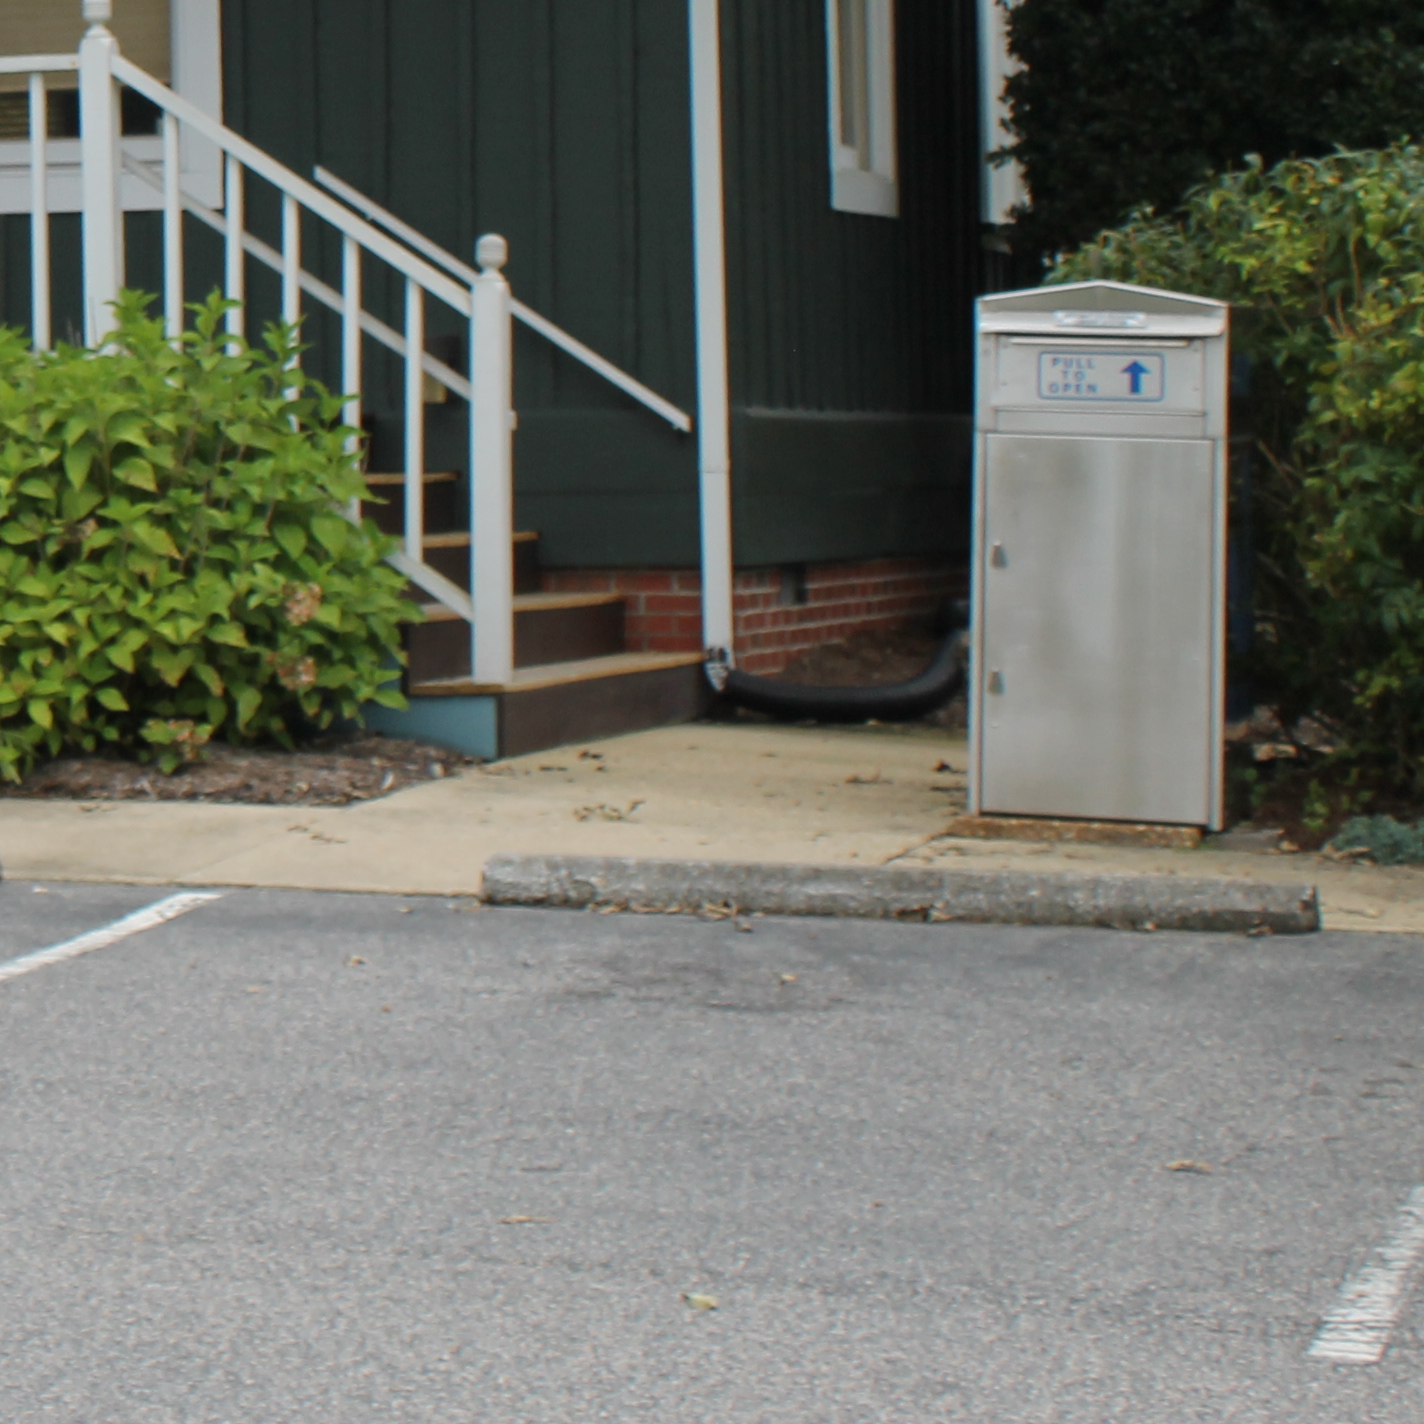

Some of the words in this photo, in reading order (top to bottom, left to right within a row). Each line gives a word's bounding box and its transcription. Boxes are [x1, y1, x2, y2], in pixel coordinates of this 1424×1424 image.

[1052, 358, 1095, 369] PULL
[1062, 371, 1086, 381] TO
[1049, 383, 1098, 394] OPEN
